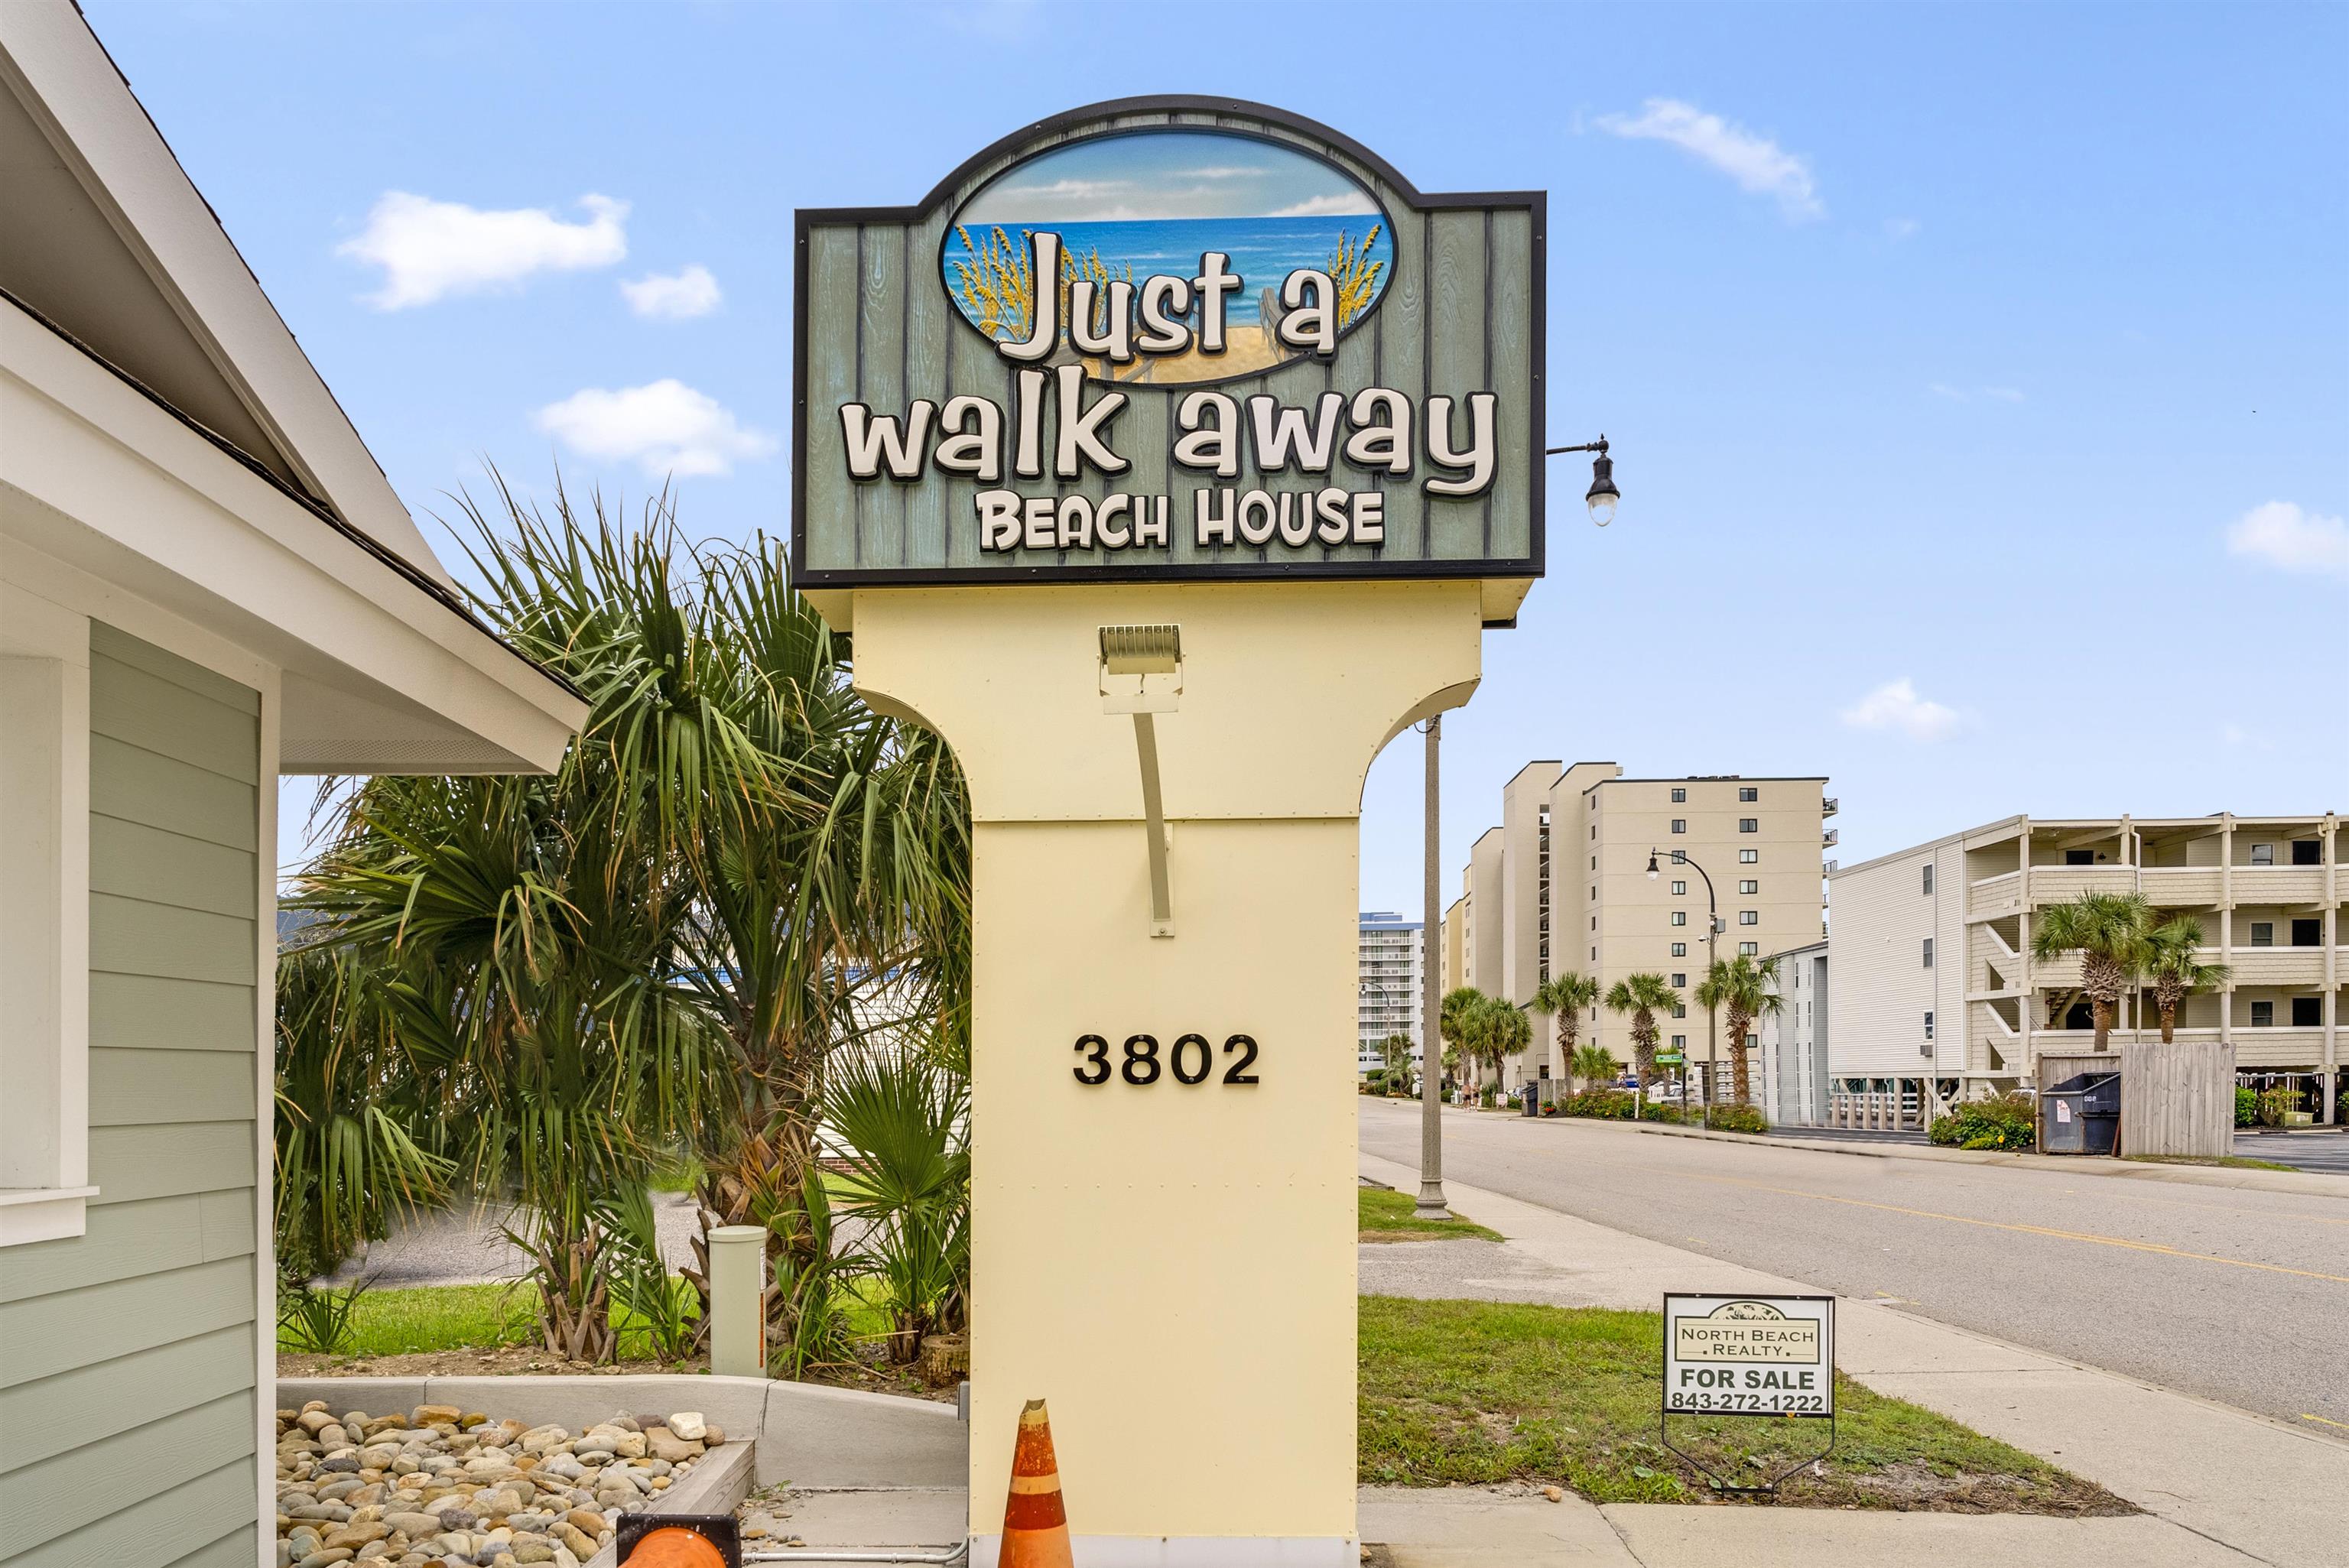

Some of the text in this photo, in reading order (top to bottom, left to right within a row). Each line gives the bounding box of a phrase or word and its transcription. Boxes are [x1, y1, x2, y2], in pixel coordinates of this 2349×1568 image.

[998, 231, 1337, 362] Just a
[840, 365, 1497, 497] walk away
[975, 487, 1384, 550] BEACH HOUSE
[1073, 1033, 1259, 1085] 3802
[1681, 1329, 1815, 1342] NORTH BEACH
[1713, 1343, 1783, 1356] REALTY
[1681, 1368, 1815, 1390] FOR SALE
[1671, 1391, 1824, 1412] 843-272-1222
